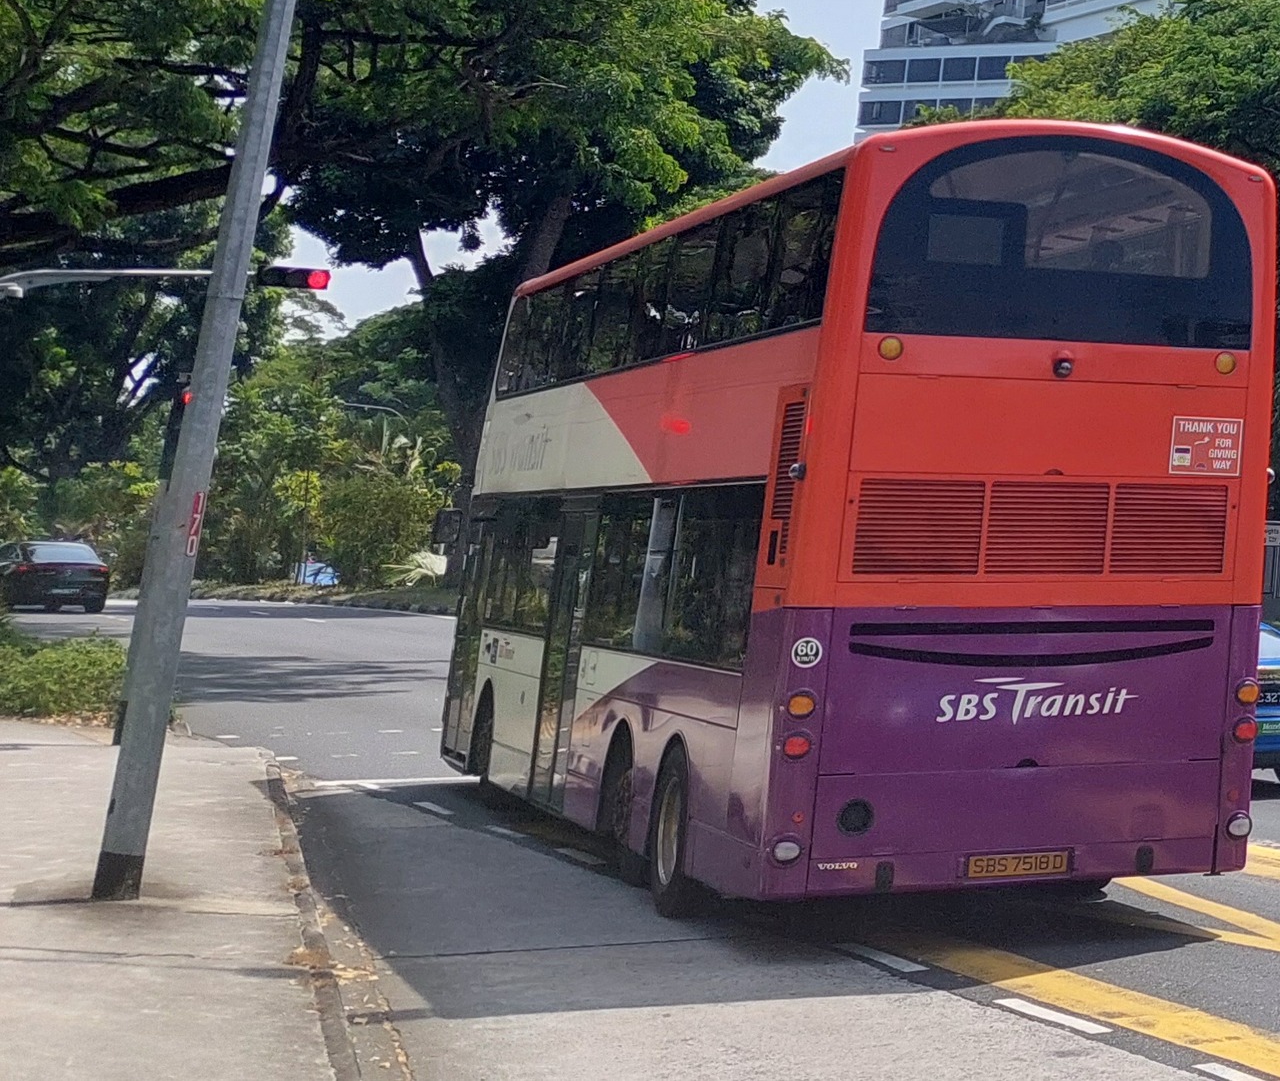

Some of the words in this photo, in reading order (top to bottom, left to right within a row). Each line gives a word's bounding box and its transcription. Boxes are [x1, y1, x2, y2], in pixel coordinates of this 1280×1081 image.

[1179, 421, 1214, 433] THANK
[1216, 422, 1238, 434] YOU
[1215, 438, 1232, 448] FOR
[1208, 449, 1237, 459] GIVING
[1212, 460, 1232, 469] WAY
[797, 642, 816, 655] 60
[936, 692, 999, 723] SBS
[996, 681, 1139, 725] Transit
[817, 862, 858, 870] VOLVO
[973, 858, 1008, 873] SBS
[1012, 856, 1049, 872] 7518
[1052, 854, 1063, 870] D
